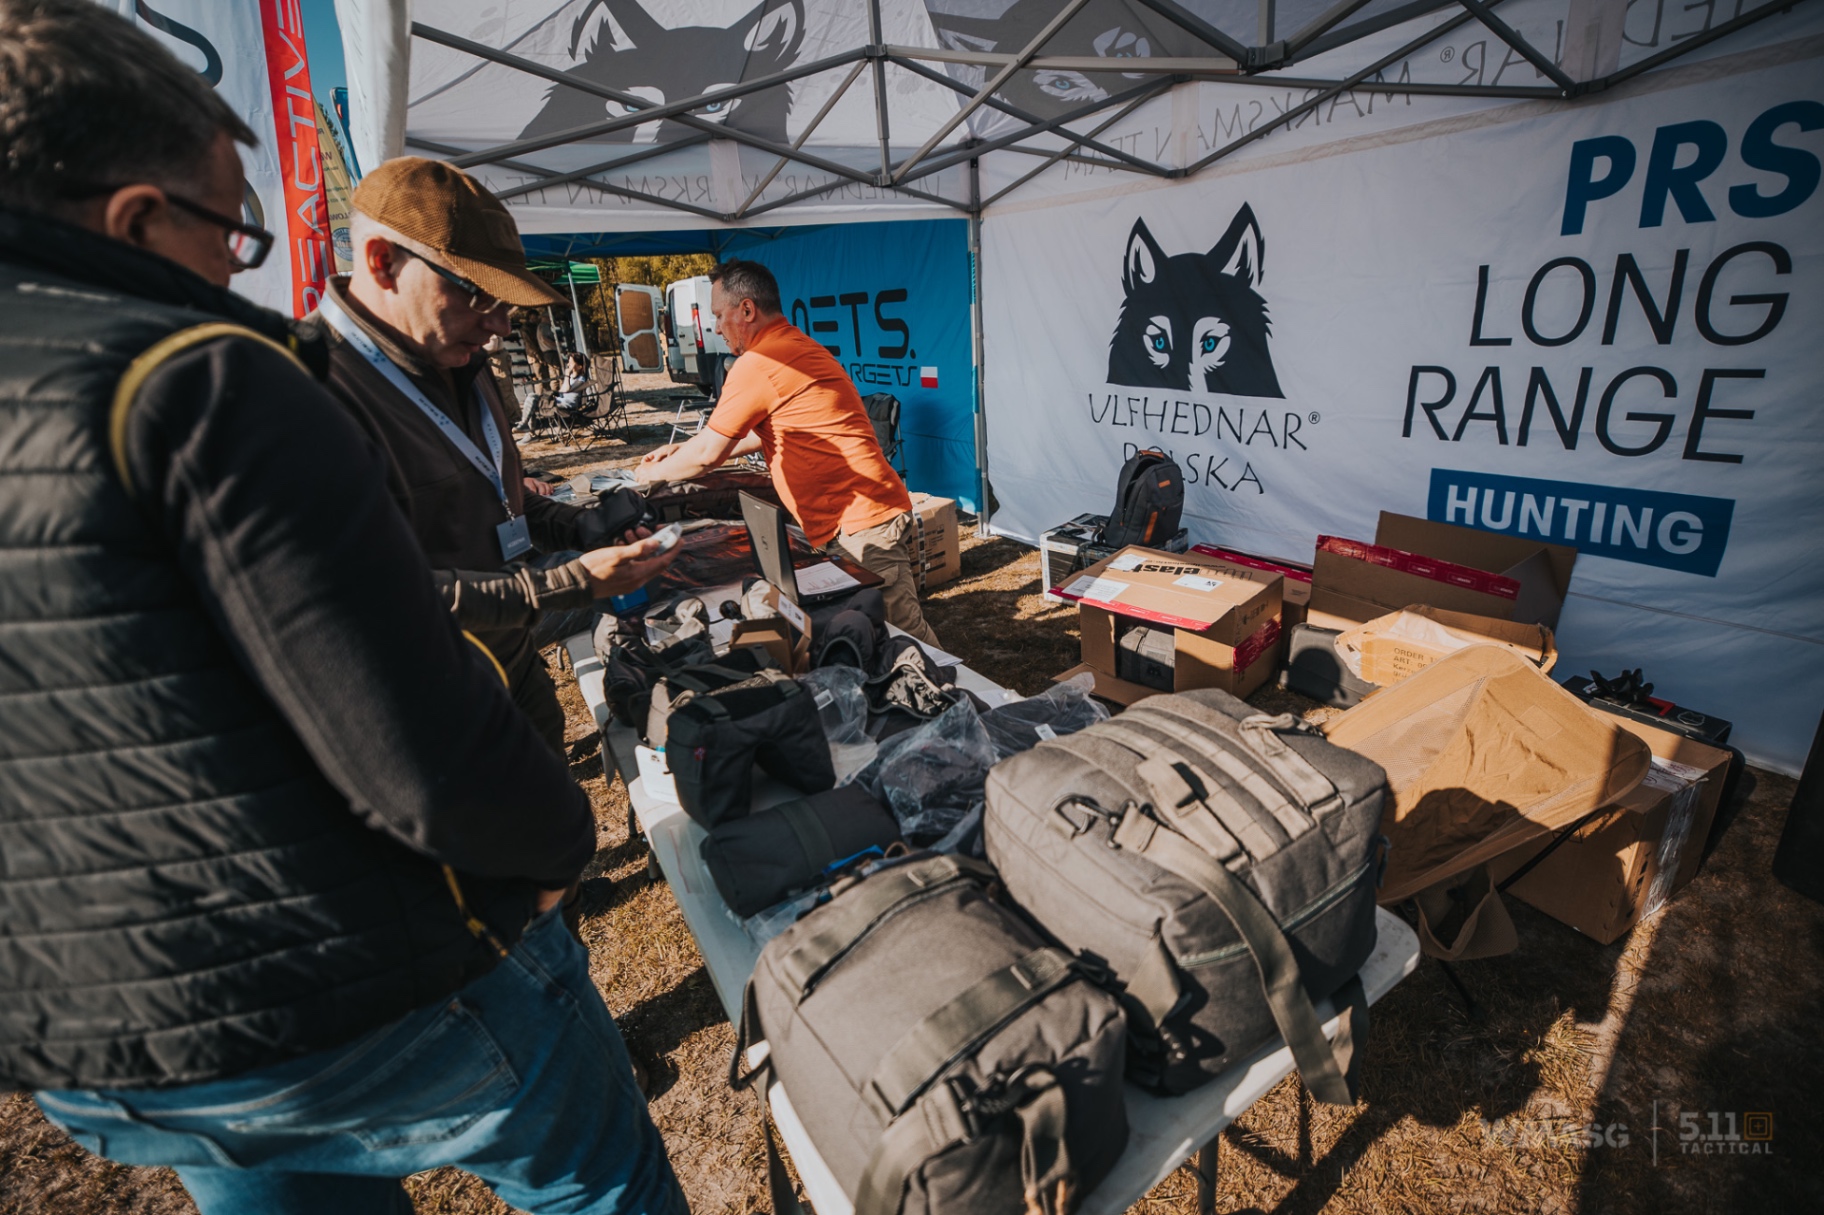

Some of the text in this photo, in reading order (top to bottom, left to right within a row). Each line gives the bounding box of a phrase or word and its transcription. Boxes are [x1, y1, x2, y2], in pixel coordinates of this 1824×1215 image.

[1560, 100, 1824, 236] PRS
[1469, 241, 1792, 347] LONG
[1402, 365, 1766, 464] RANGE
[1446, 484, 1704, 555] HUNTING
